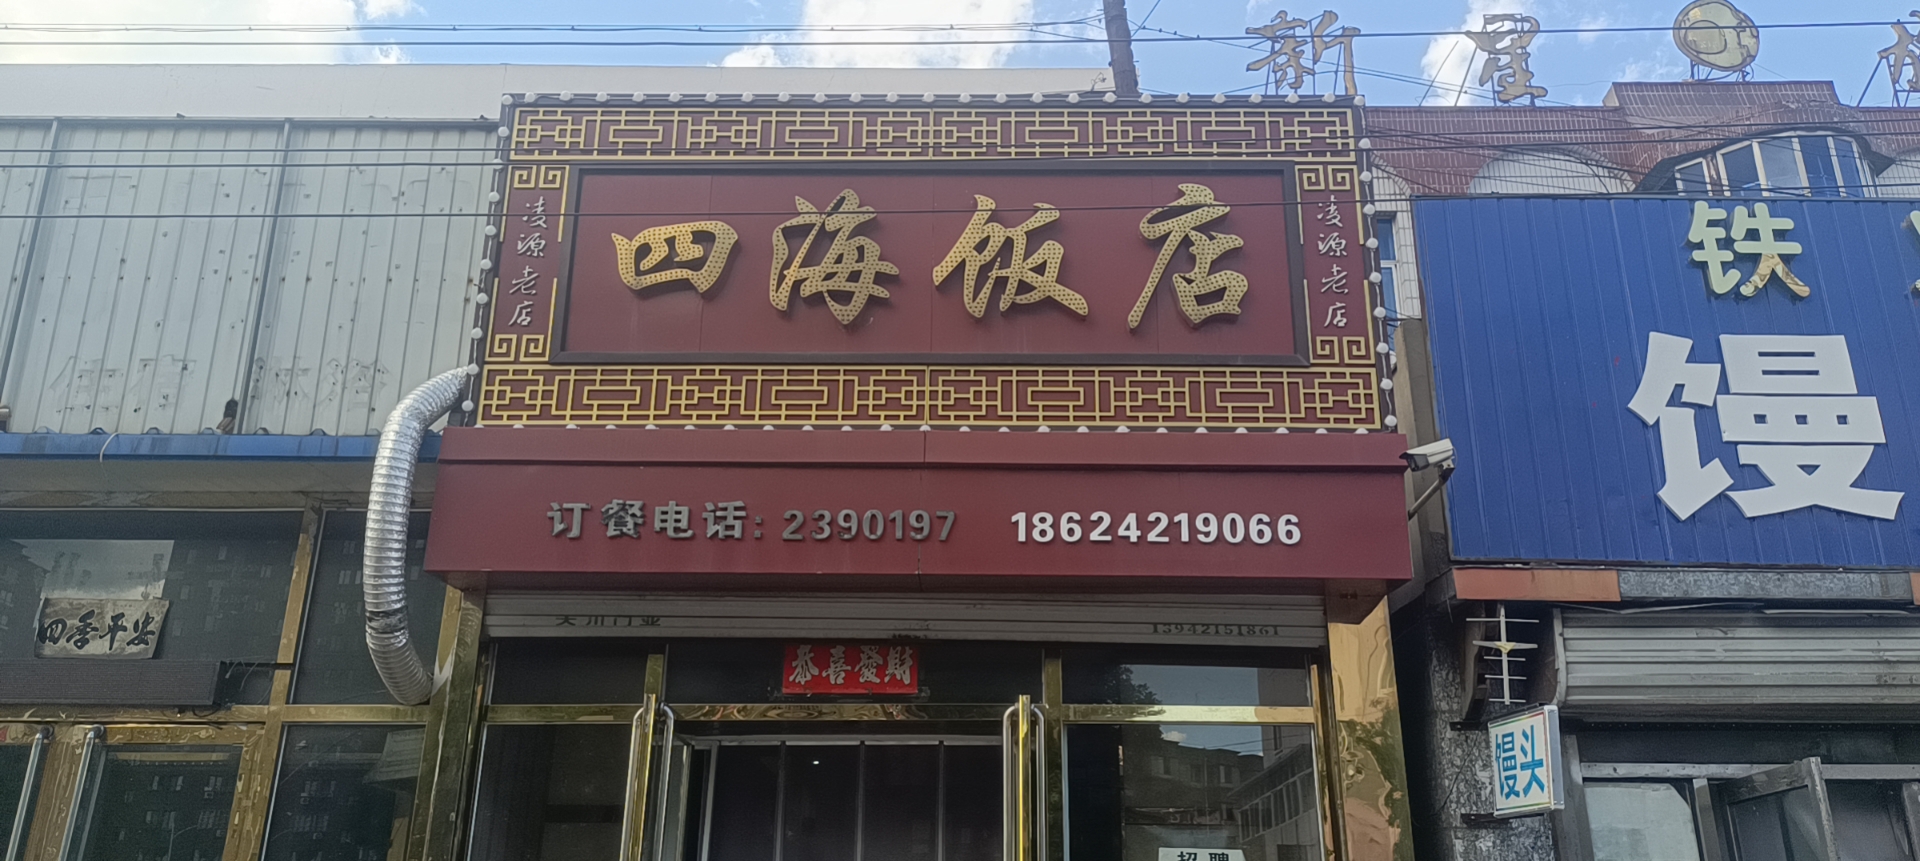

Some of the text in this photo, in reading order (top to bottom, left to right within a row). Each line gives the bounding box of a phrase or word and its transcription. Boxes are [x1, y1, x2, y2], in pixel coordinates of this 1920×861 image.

[508, 196, 548, 326] 凌源老店
[611, 184, 1249, 330] 四海饭店
[1316, 195, 1349, 327] 凌源老店
[1627, 331, 1905, 521] 馒
[781, 509, 956, 541] 2390197
[1010, 511, 1301, 545] 18624219066
[1495, 724, 1546, 800] 馒头
